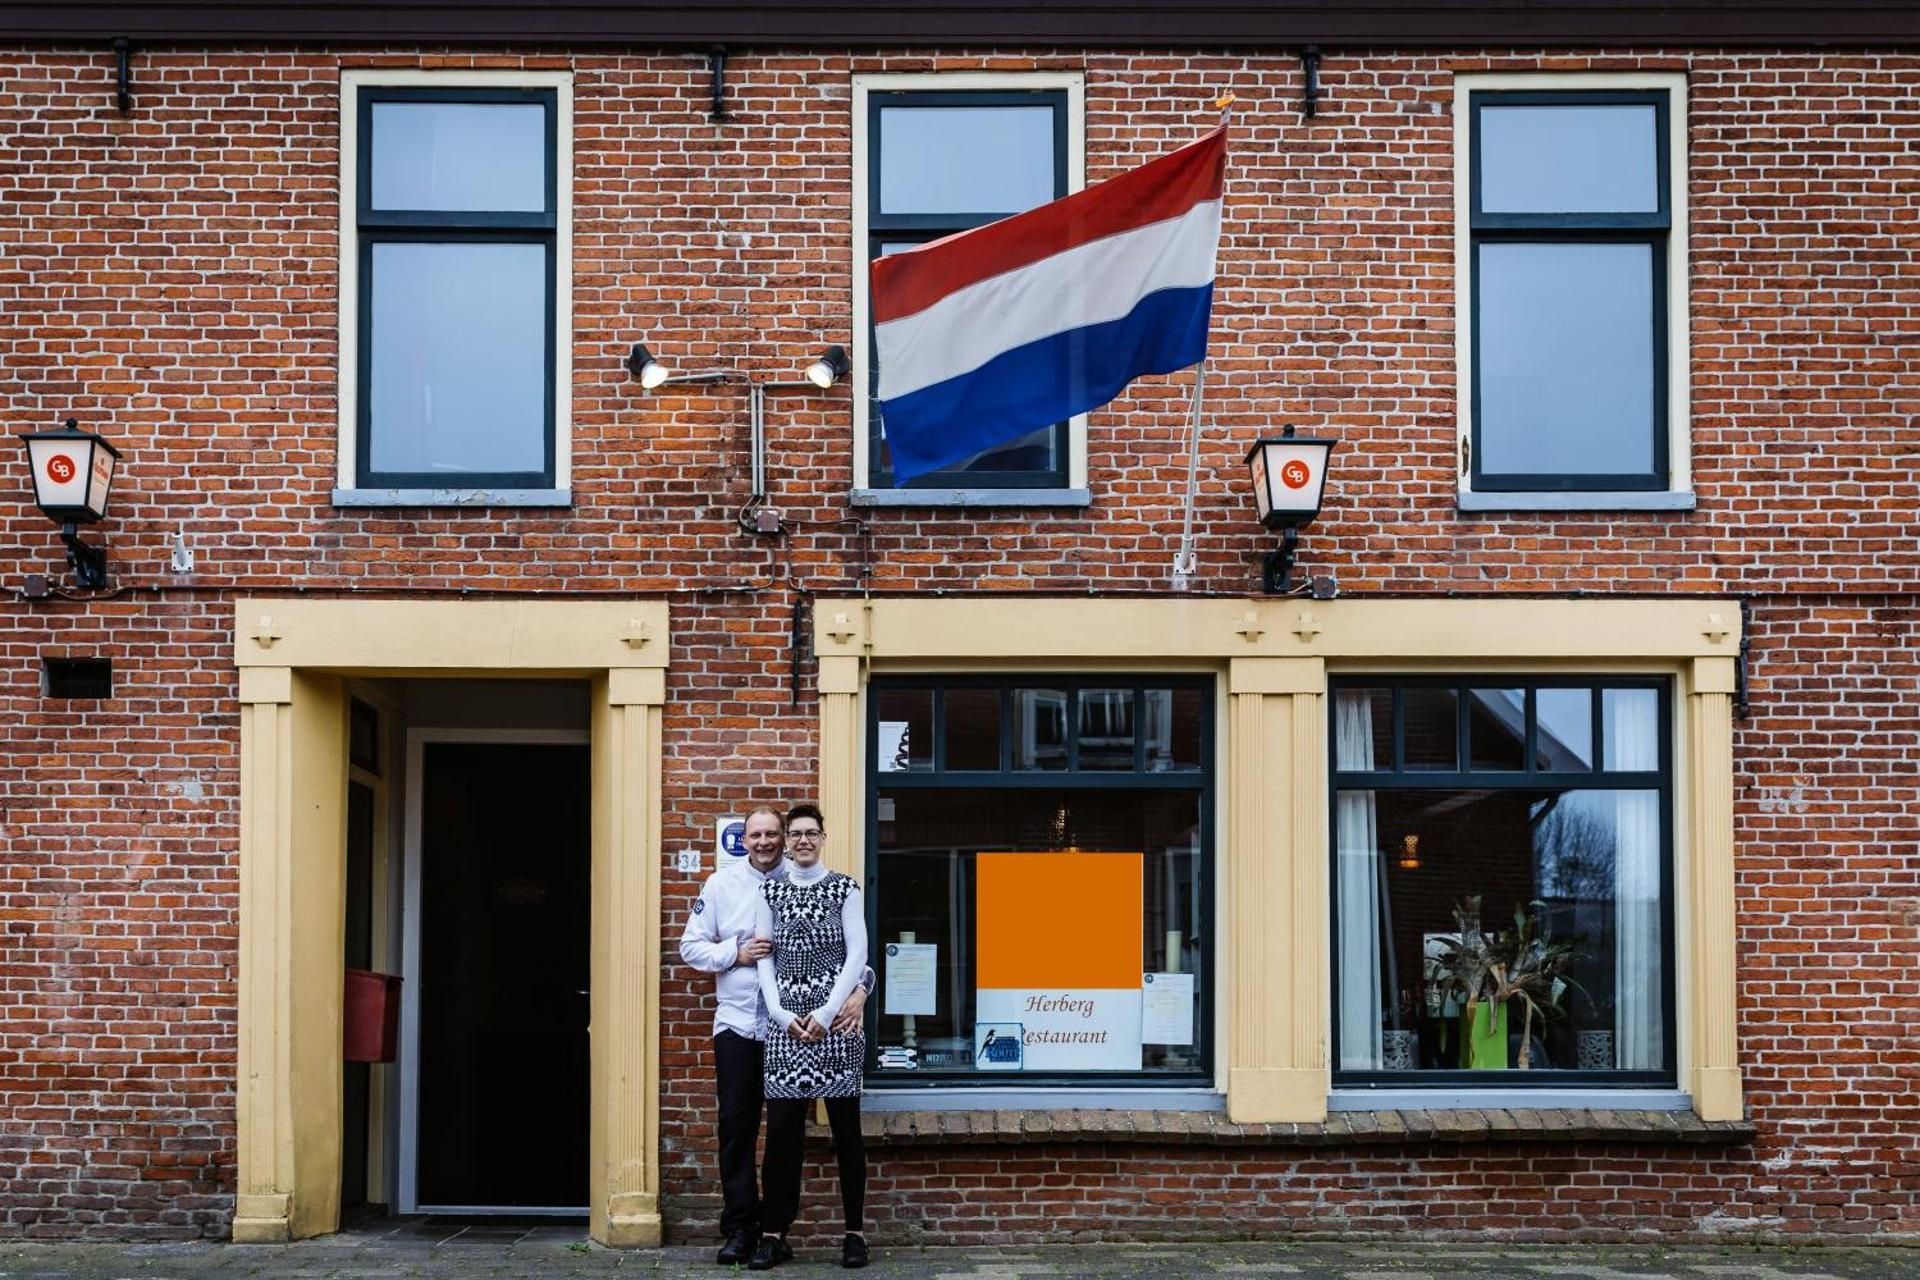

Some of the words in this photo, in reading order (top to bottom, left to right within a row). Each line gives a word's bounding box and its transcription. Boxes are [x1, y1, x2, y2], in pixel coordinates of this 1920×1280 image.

[52, 460, 70, 477] GB
[1287, 465, 1304, 483] GB
[680, 854, 698, 869] 34
[1024, 994, 1094, 1018] Herberg
